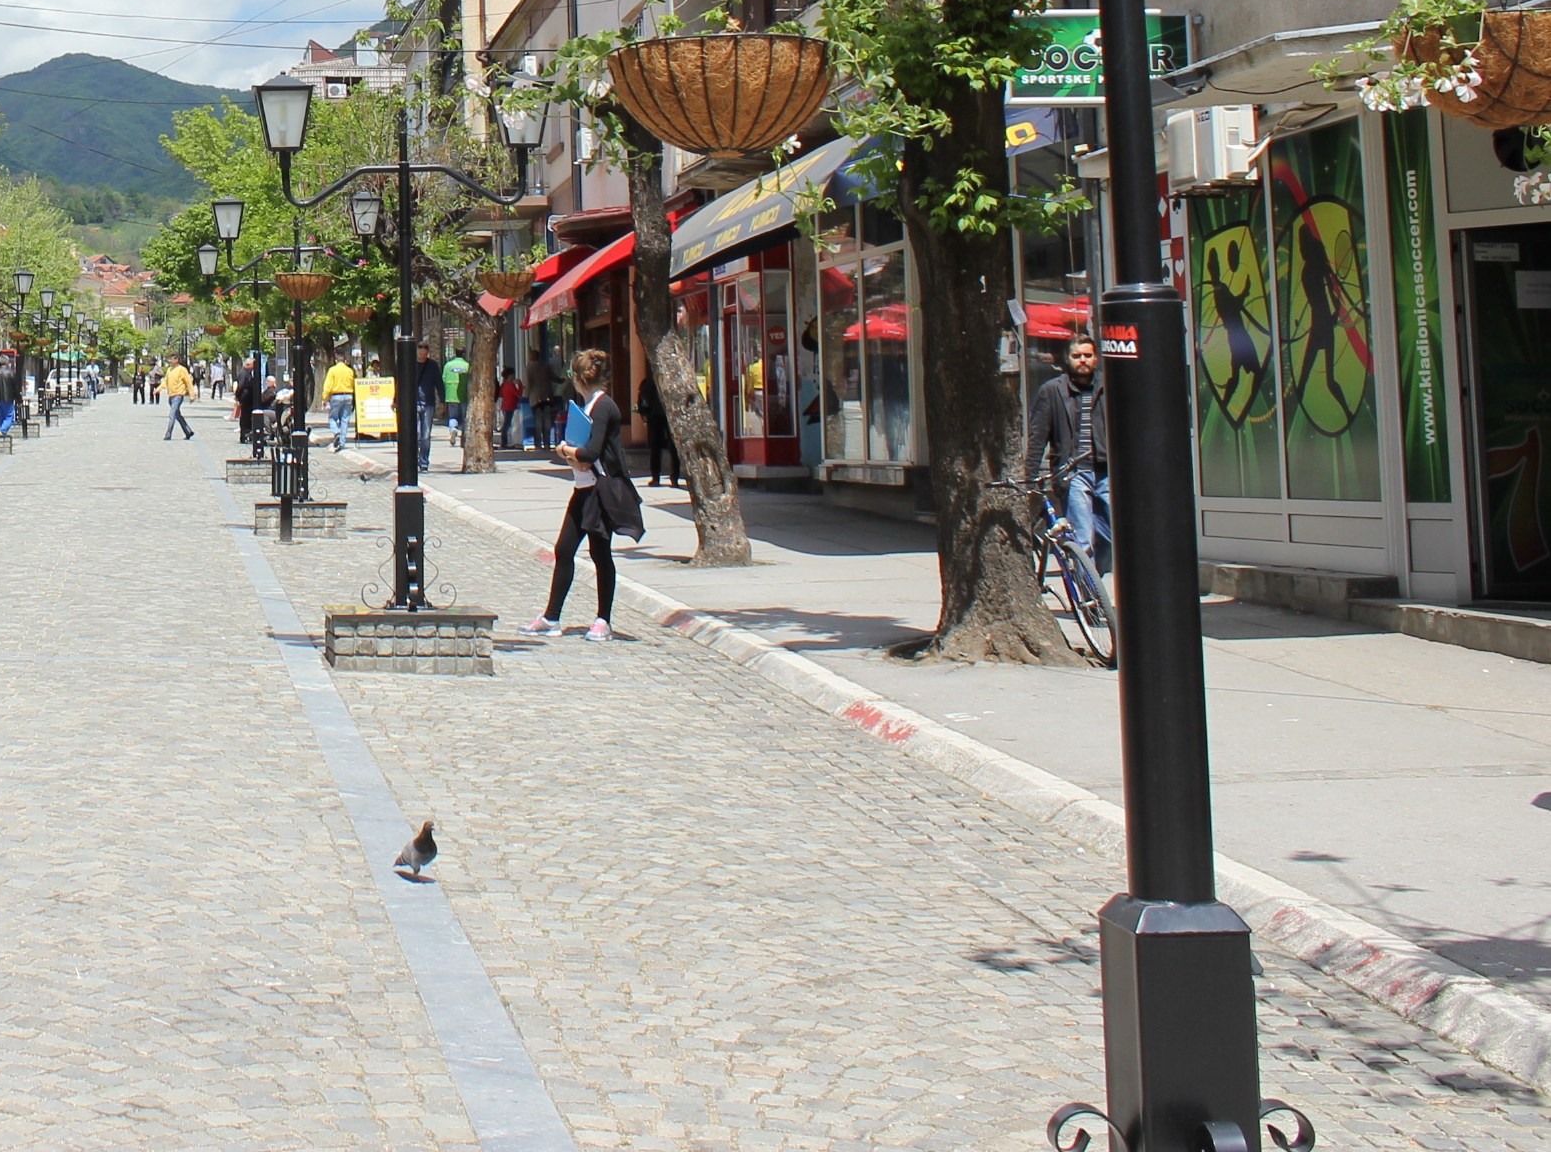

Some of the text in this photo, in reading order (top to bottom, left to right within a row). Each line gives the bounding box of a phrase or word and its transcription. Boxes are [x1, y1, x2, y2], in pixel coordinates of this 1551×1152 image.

[1022, 43, 1177, 72] OCR
[1021, 74, 1091, 85] SPORTSKE
[1406, 169, 1436, 446] www.kladionicasoccer.com
[769, 331, 785, 340] YES
